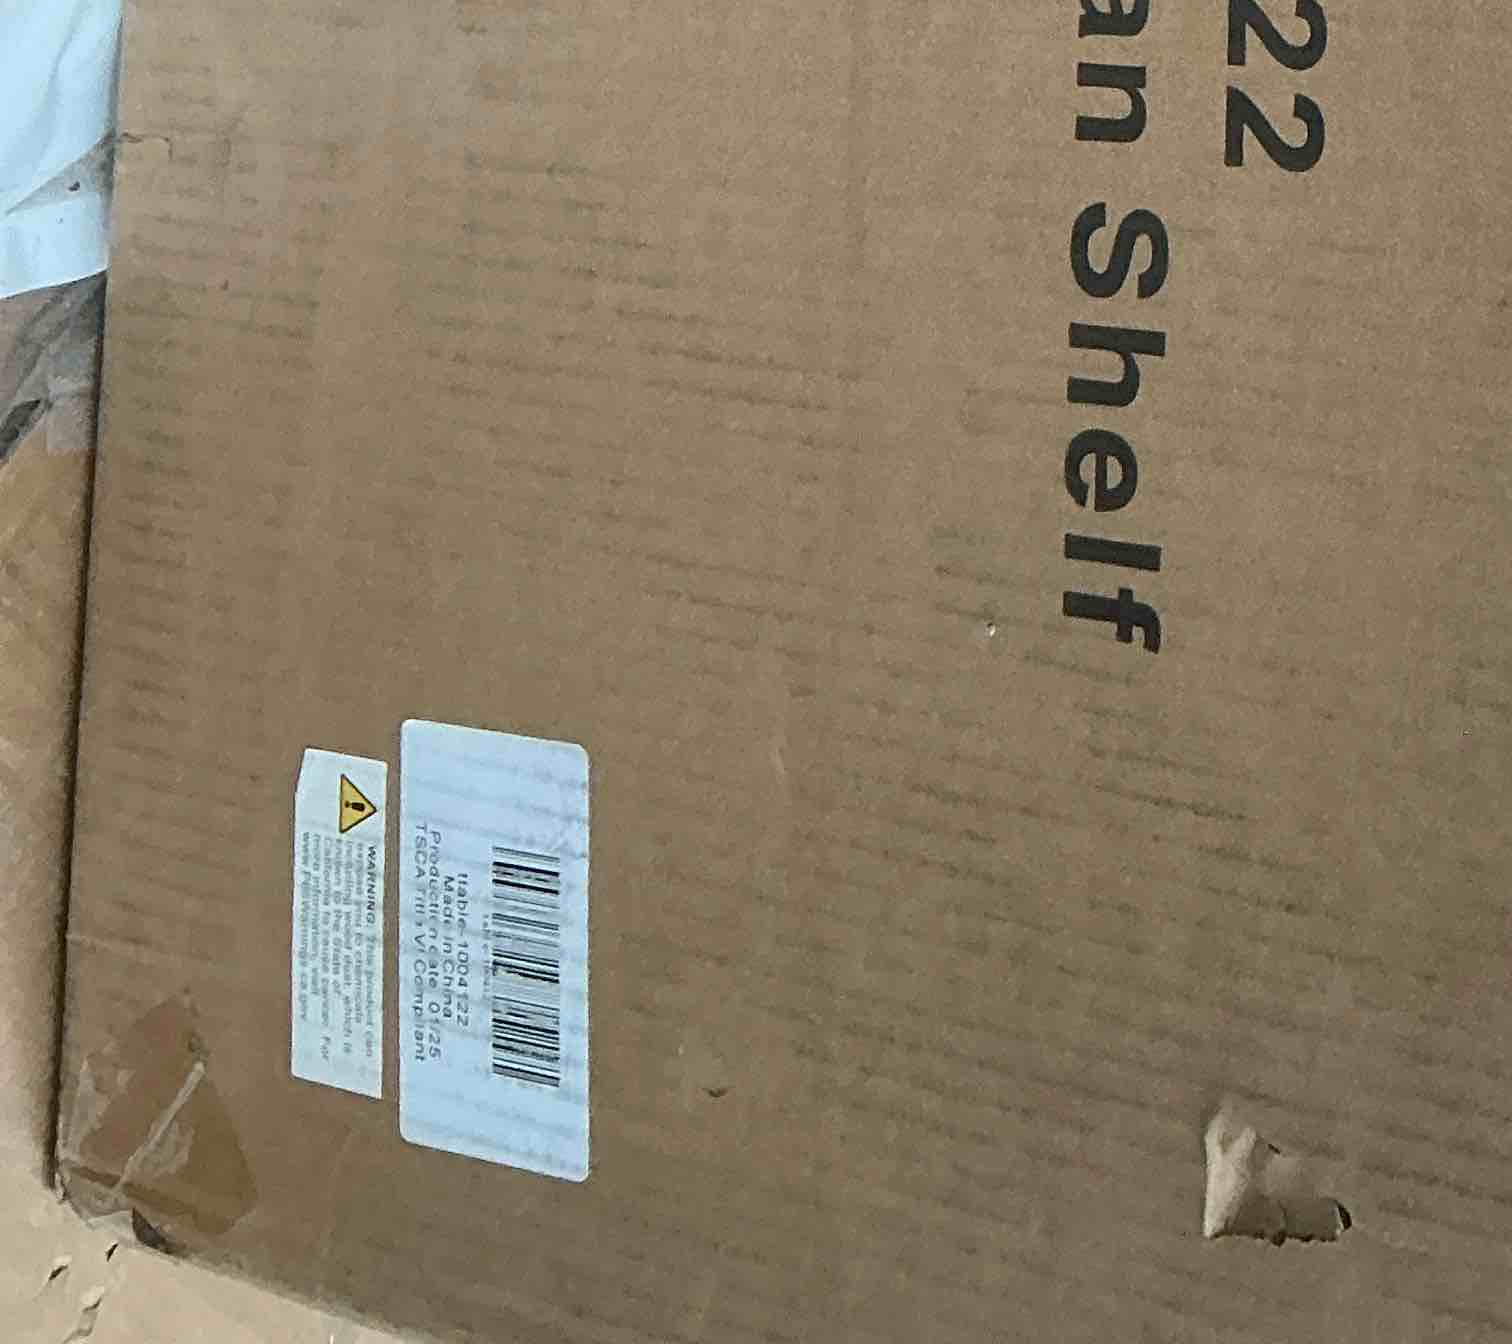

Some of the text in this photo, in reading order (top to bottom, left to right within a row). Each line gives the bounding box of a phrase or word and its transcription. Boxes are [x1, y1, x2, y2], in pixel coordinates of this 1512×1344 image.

[1062, 202, 1168, 654] Shelf
[415, 824, 427, 878] TSCA
[363, 971, 375, 1026] product
[443, 959, 455, 1018] China
